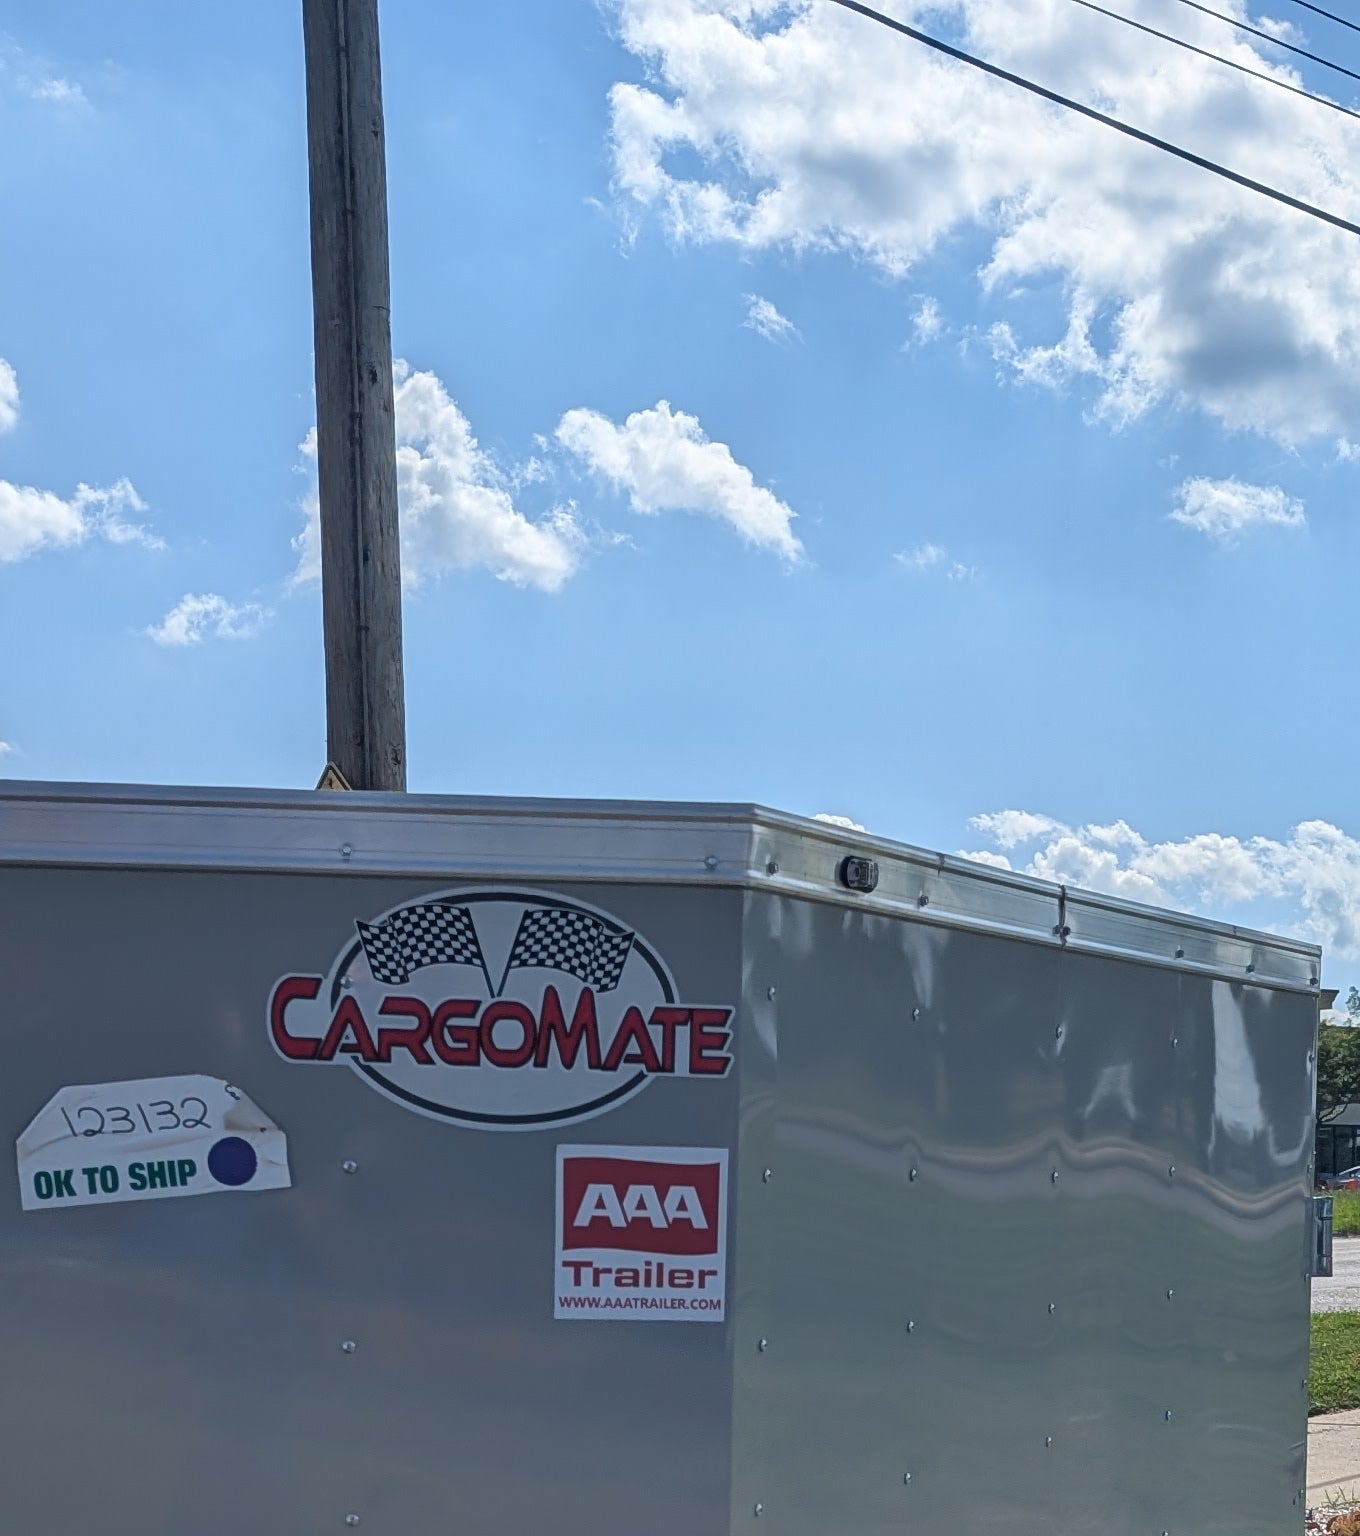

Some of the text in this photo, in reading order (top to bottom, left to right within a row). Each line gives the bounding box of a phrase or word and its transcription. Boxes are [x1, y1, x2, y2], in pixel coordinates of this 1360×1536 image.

[60, 1097, 212, 1138] 123132
[33, 1158, 197, 1200] OK TO SHIP
[572, 1182, 709, 1230] AAA
[561, 1260, 718, 1289] Trailer
[558, 1296, 721, 1311] WWW.AAATRAILER.COM
